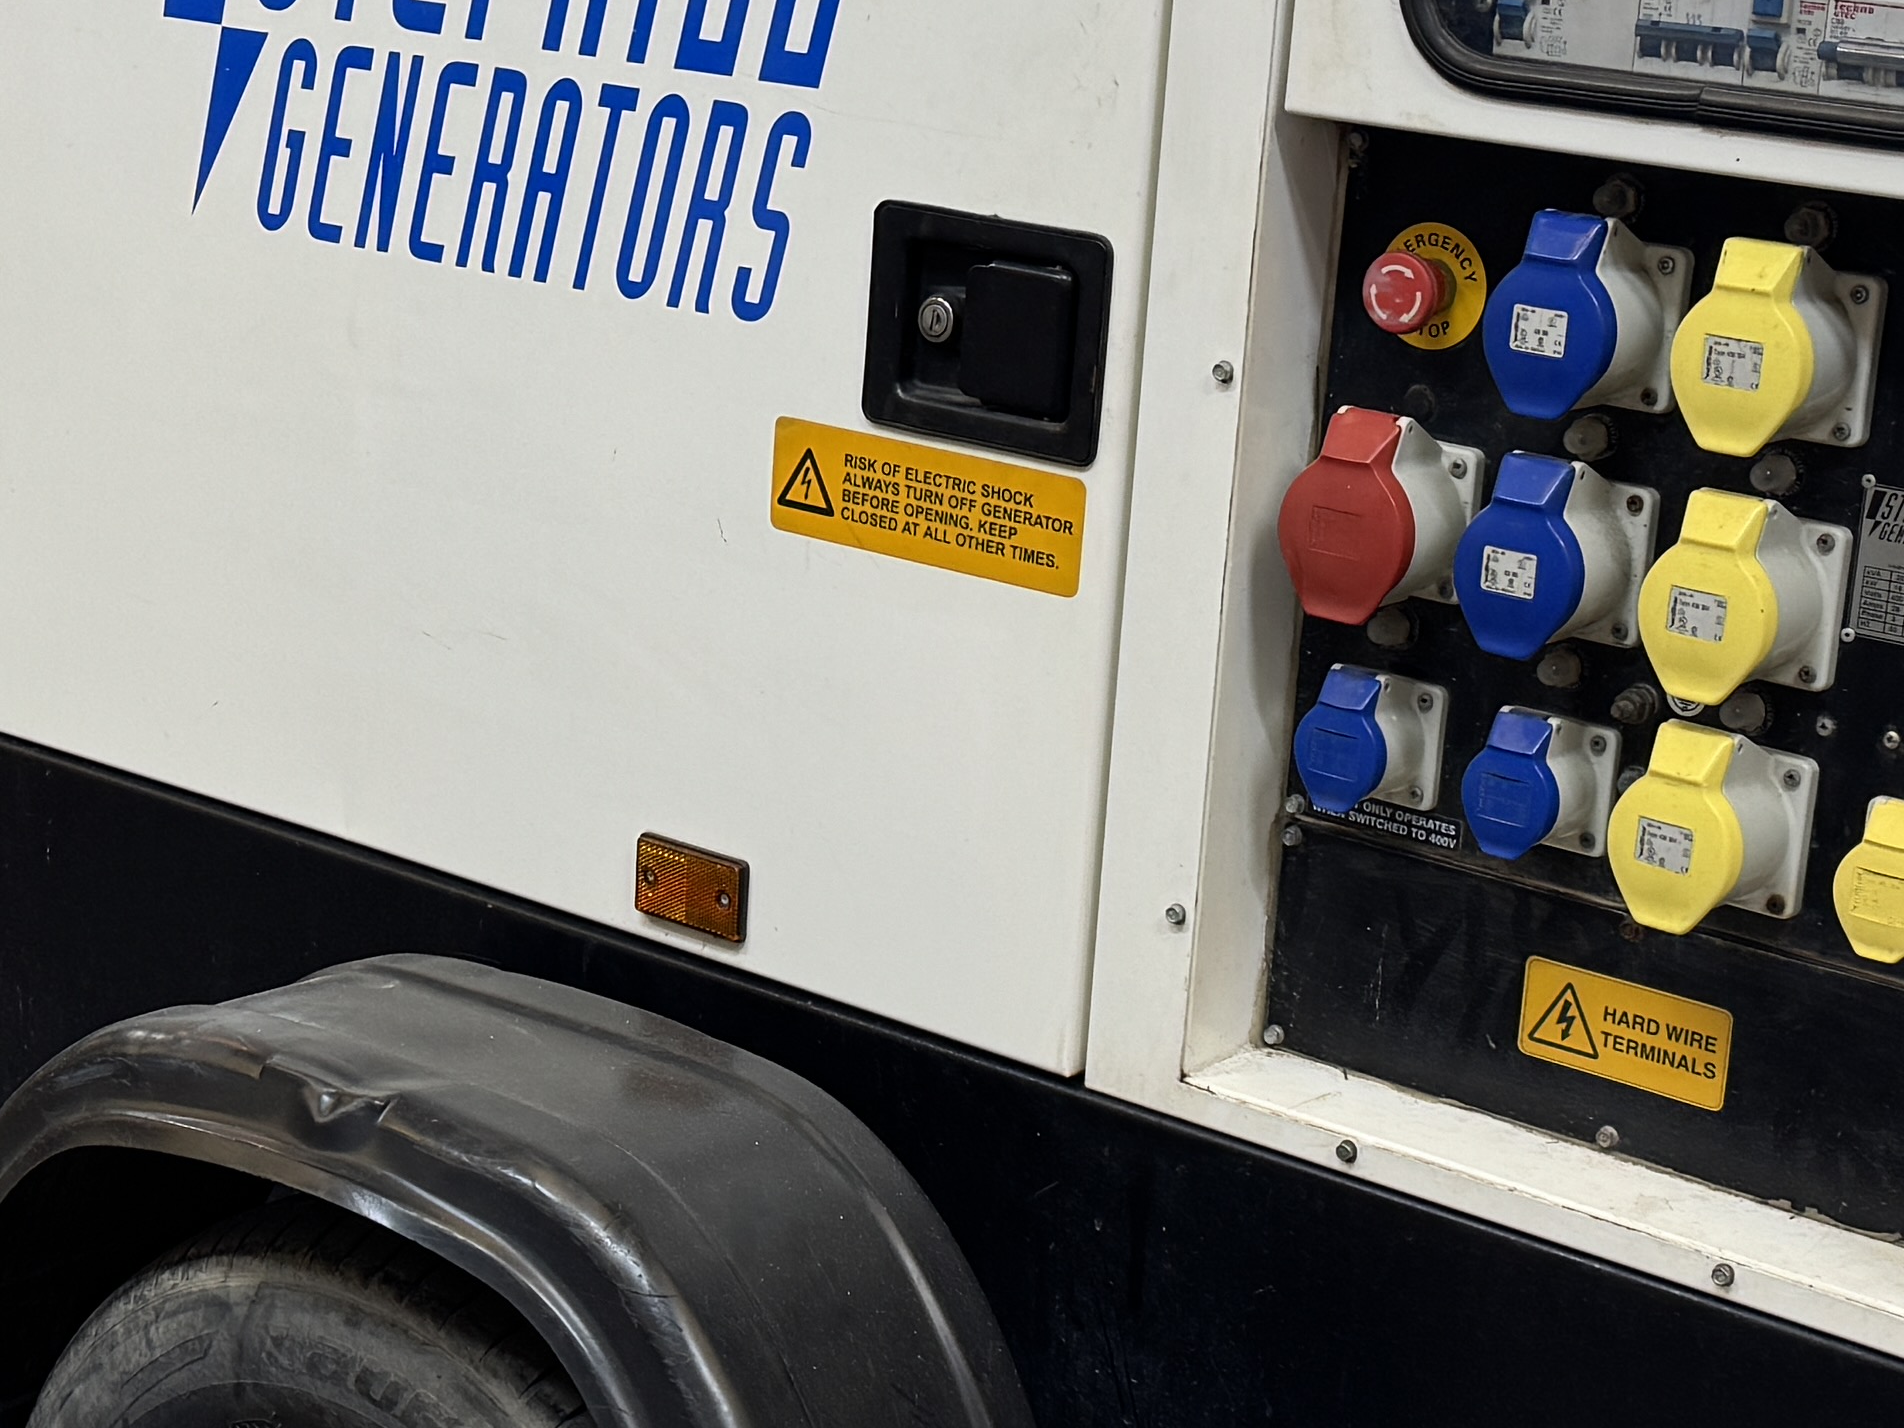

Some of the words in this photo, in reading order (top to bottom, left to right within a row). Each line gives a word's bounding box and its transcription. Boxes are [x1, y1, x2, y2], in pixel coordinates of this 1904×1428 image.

[256, 38, 812, 322] GENERATORS
[1404, 232, 1478, 284] ERGENCY
[842, 472, 900, 496] ALWAYS
[905, 486, 944, 507] TURN
[948, 495, 977, 512] OFF
[981, 503, 1074, 536] GENERATOR
[844, 453, 877, 473] RISK
[881, 461, 901, 477] OF
[905, 467, 977, 495] ELECTRIC
[981, 484, 1035, 508] SHOCK
[841, 507, 898, 531] CLOSED
[901, 520, 920, 536] AT
[923, 525, 952, 545] ALL
[955, 533, 1006, 558] OTHER
[1009, 545, 1060, 570] TIMES.
[842, 489, 900, 514] BEFORE
[903, 503, 973, 532] OPENING.
[977, 520, 1018, 541] KEEP
[1348, 811, 1408, 836] SWITCHED
[1411, 827, 1427, 841] TO
[1429, 833, 1457, 849] 400V
[1362, 801, 1394, 818] ONLY
[1395, 811, 1457, 836] OPERATES
[1600, 1030, 1717, 1080] TERMINALS
[1603, 1005, 1660, 1037] HARD
[1666, 1023, 1718, 1054] WIRE
